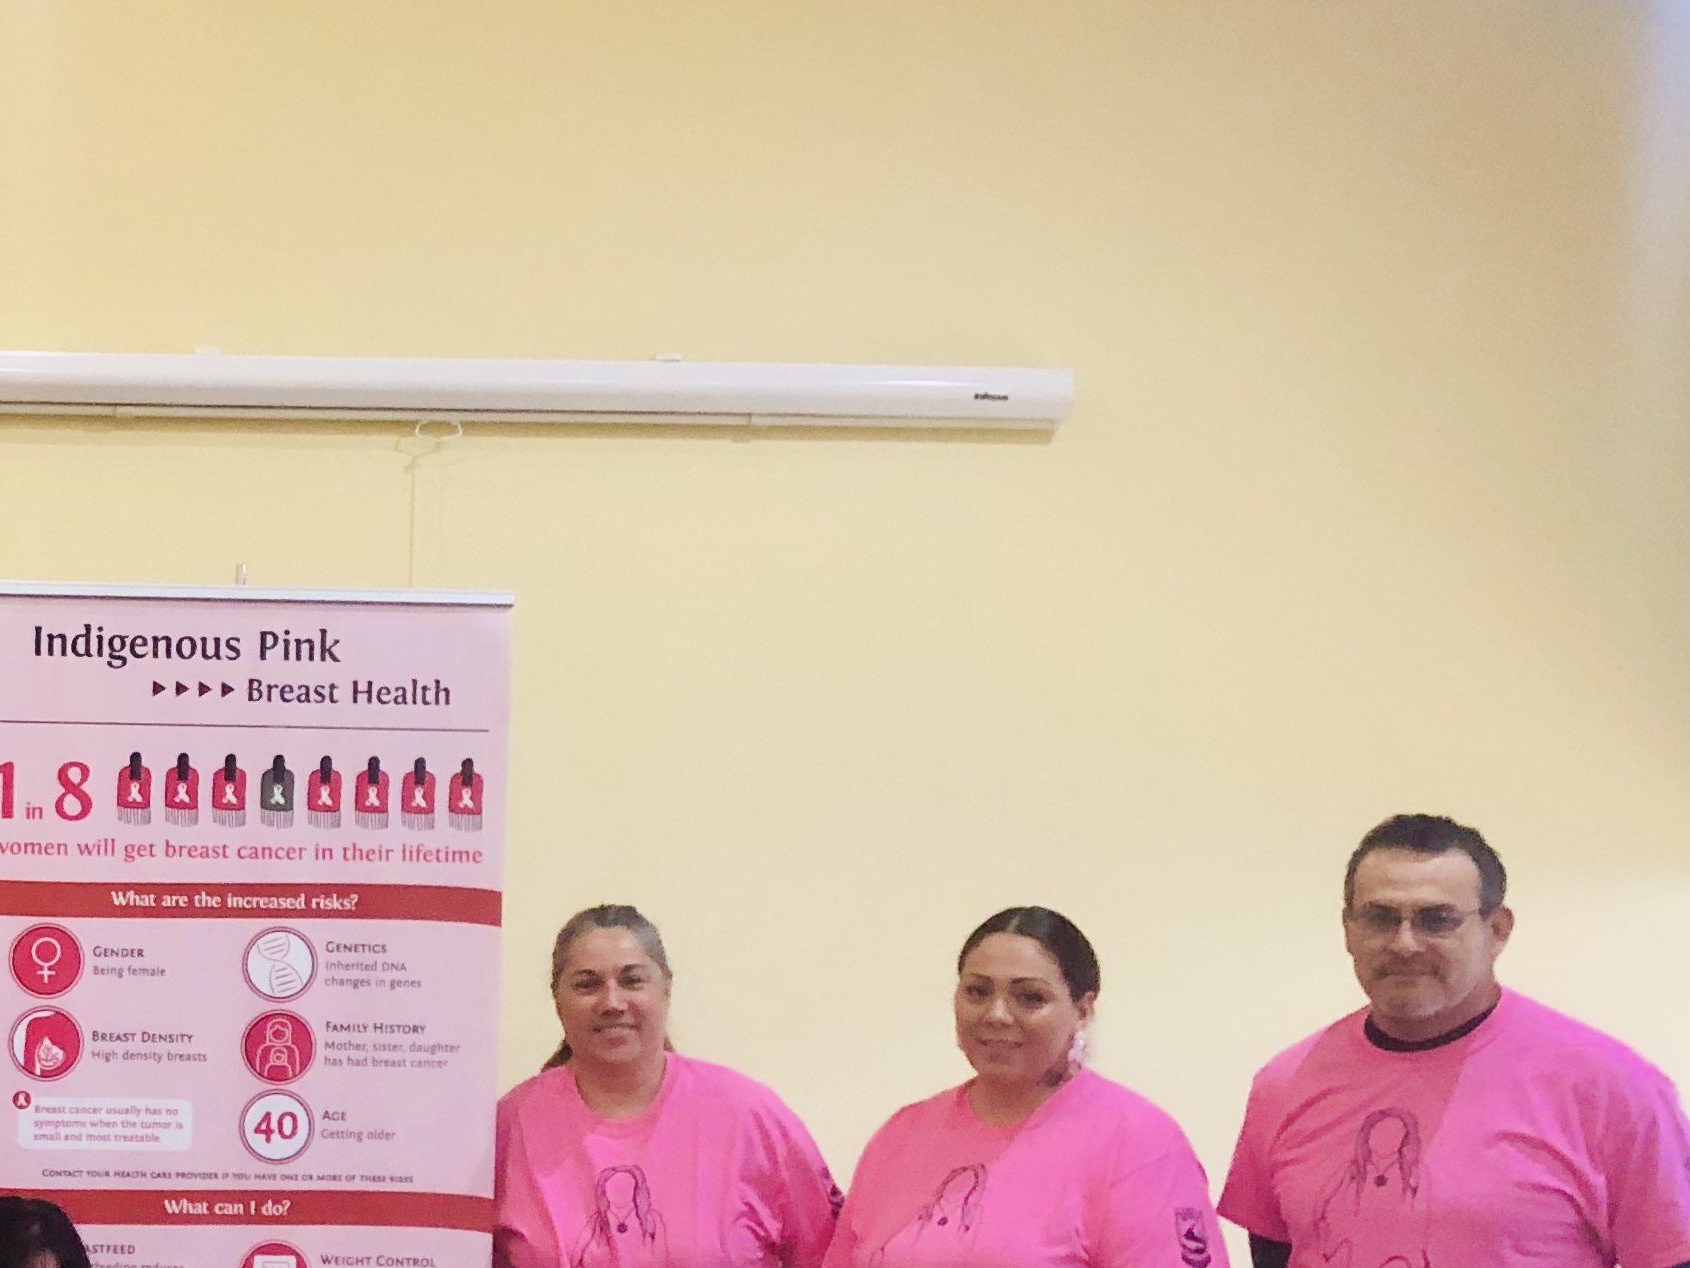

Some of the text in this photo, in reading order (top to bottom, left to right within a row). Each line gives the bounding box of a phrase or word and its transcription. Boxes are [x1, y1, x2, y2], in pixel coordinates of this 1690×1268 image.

[33, 624, 341, 668] Indigenous Pink
[246, 678, 451, 706] Breast Health
[25, 802, 43, 821] in
[54, 760, 93, 822] 8
[77, 838, 115, 857] will
[123, 842, 157, 863] get
[164, 840, 229, 859] breast
[236, 845, 308, 861] cancer
[314, 842, 333, 862] in
[342, 843, 394, 863] their
[401, 843, 483, 865] lifetime
[110, 889, 359, 912] What are the increased risks?
[93, 965, 166, 979] Being female
[325, 960, 407, 972] Inherited DNA
[324, 976, 422, 991] changes in genes
[324, 1040, 461, 1056] Mother, sister, daughter
[91, 1049, 208, 1064] High density breasts
[324, 1055, 449, 1069] has had breast cancer
[34, 1105, 179, 1118] Breast cancer usually has no
[33, 1119, 183, 1130] symptoms when the tumor is
[253, 1110, 299, 1144] 40
[33, 1132, 61, 1141] small
[63, 1132, 83, 1142] and
[86, 1133, 112, 1142] most
[321, 1129, 397, 1143] Getting older
[164, 1198, 291, 1216] What can I do?
